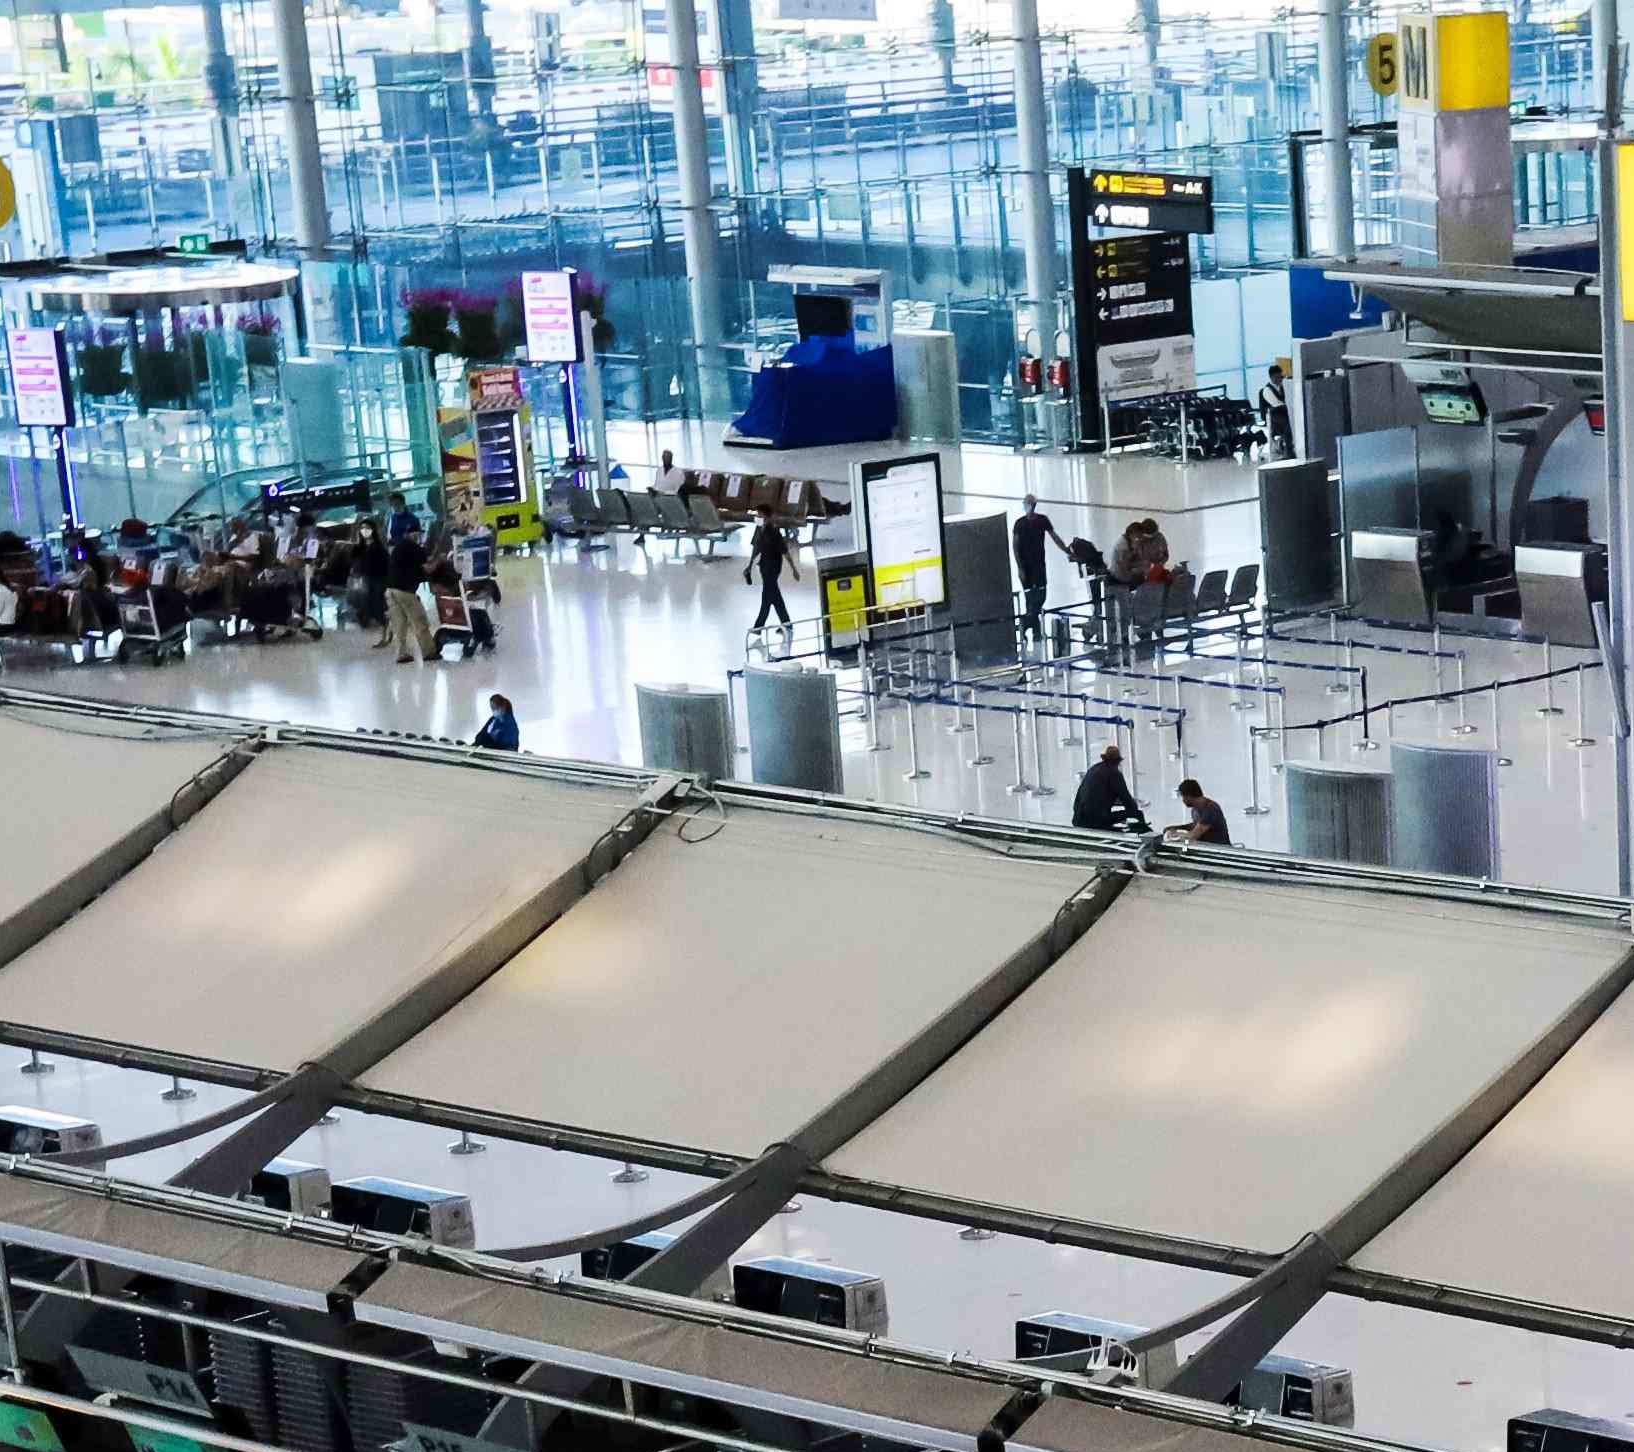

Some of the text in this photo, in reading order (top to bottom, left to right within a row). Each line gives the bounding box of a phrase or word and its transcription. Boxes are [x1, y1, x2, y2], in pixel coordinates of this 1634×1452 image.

[1379, 42, 1395, 85] 5
[1402, 25, 1428, 100] M
[146, 1374, 197, 1405] P14
